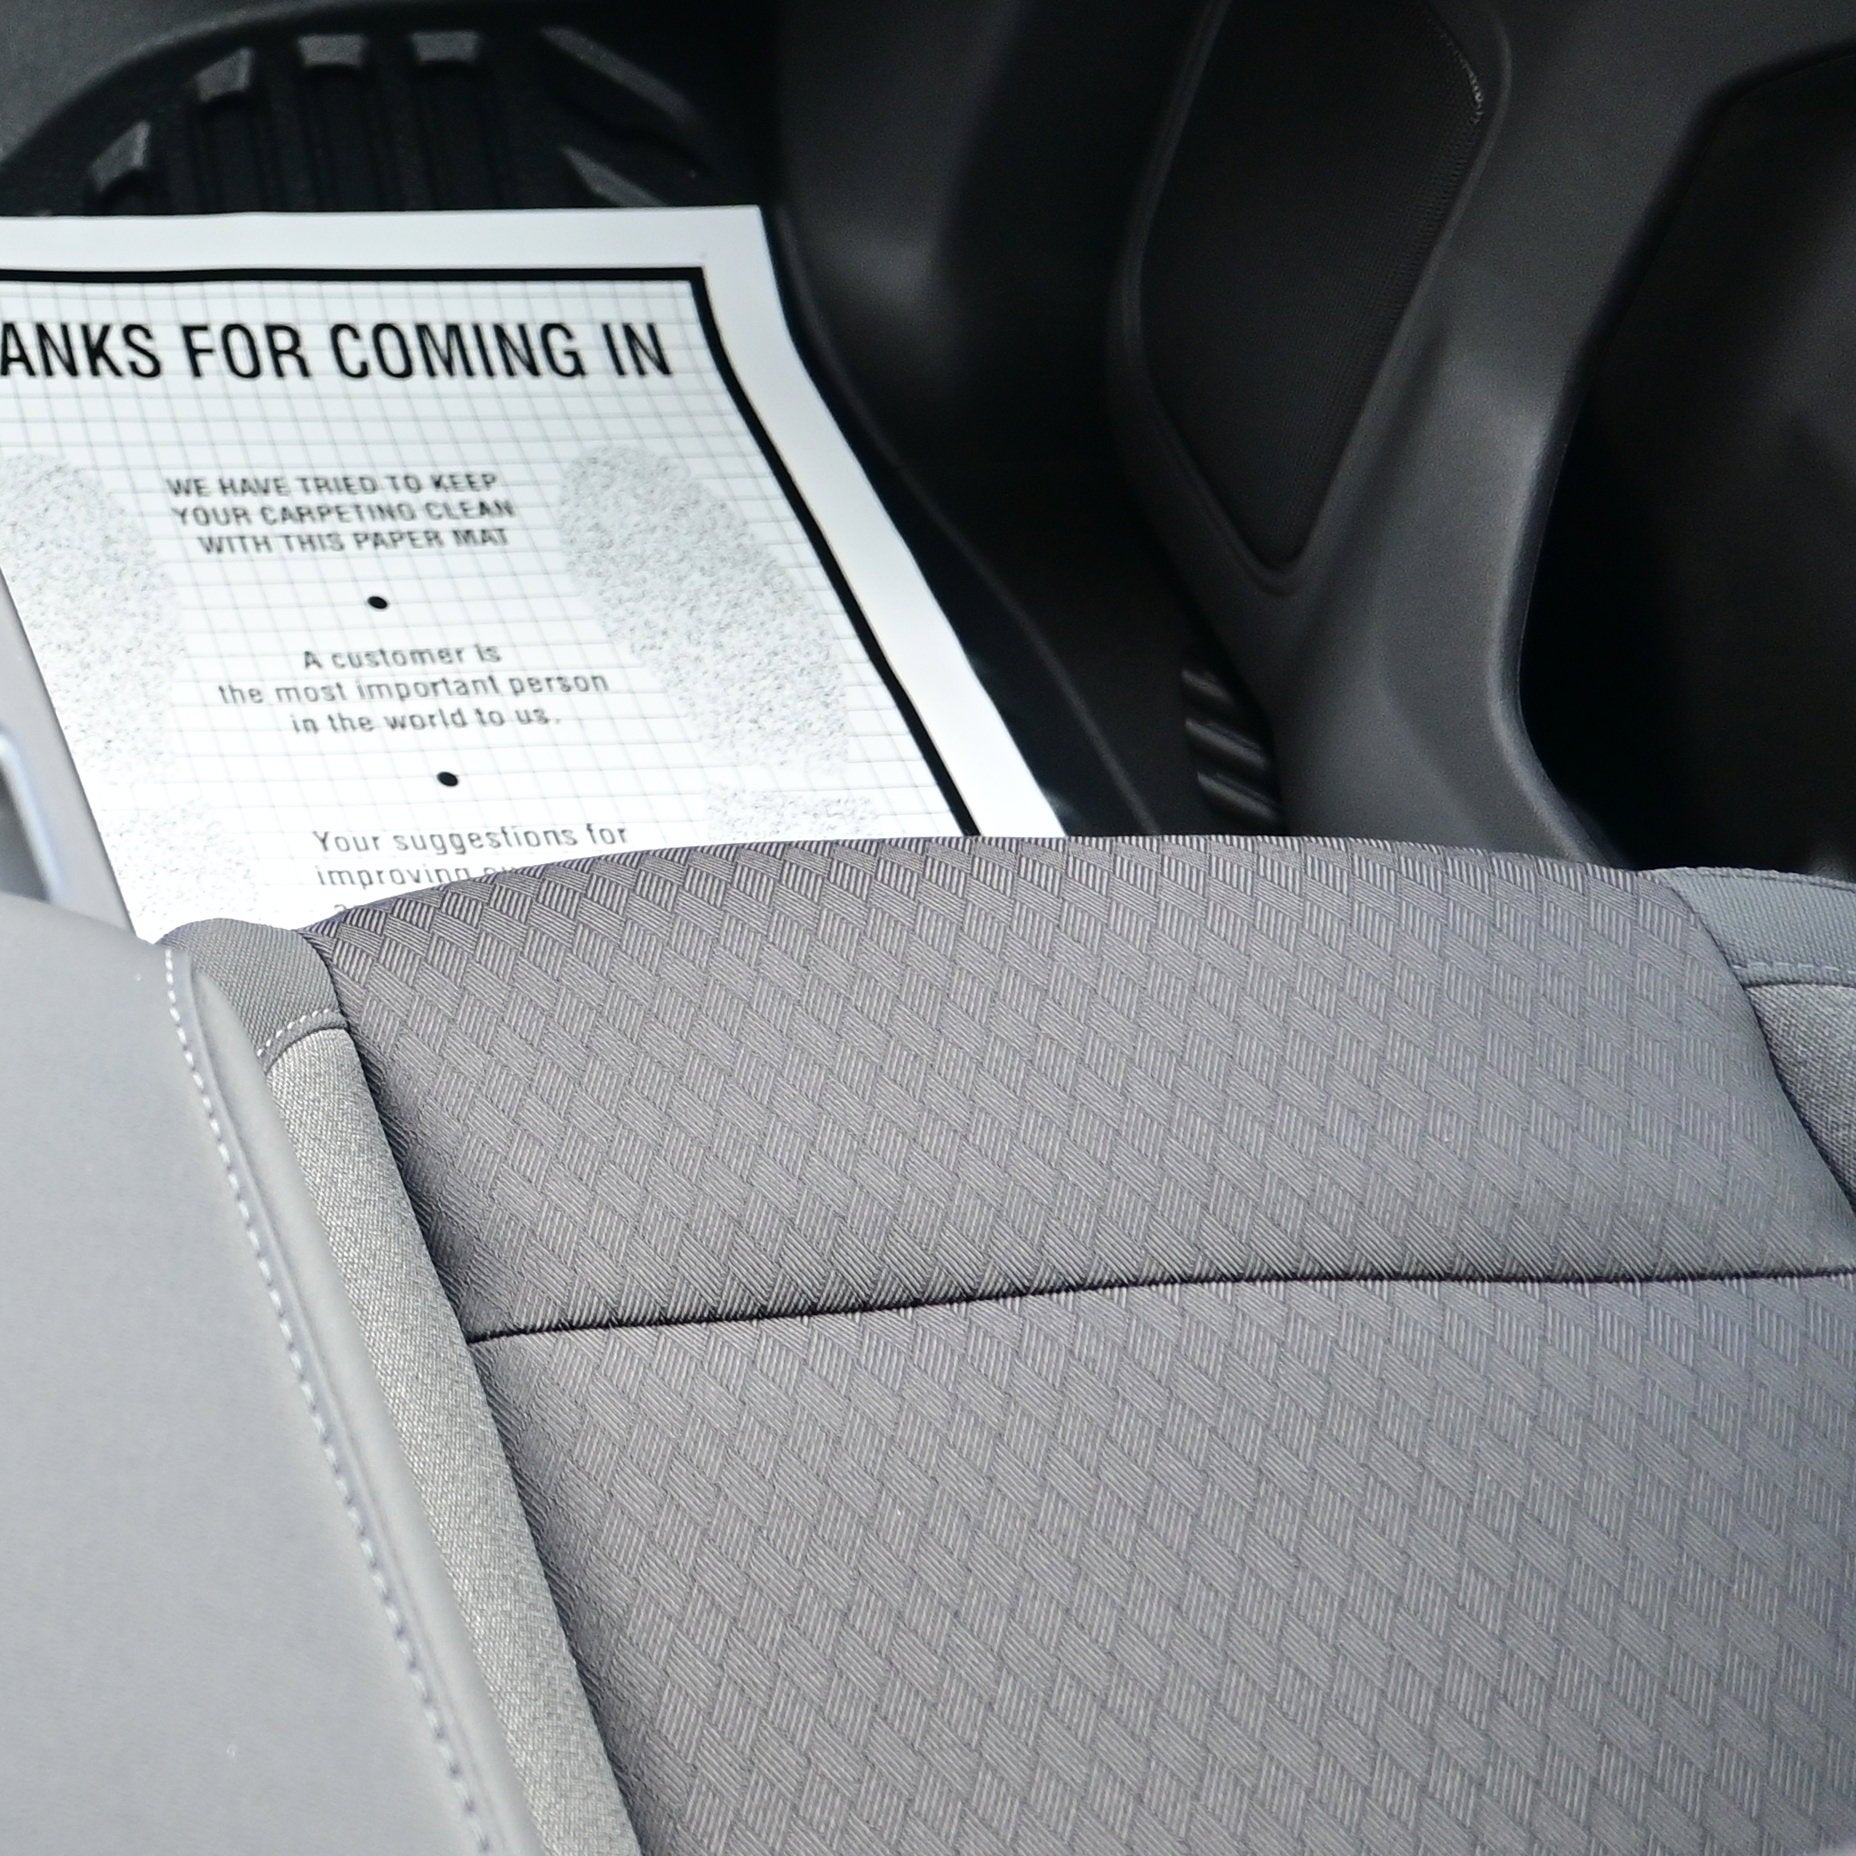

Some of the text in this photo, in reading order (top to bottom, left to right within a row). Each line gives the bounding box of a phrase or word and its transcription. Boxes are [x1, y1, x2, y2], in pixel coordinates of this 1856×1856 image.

[181, 322, 312, 380] FOR
[330, 321, 587, 380] COMING
[600, 321, 673, 378] IN
[166, 471, 499, 498] WE HAVE TRIED TO KEEP
[171, 498, 517, 527] YOUR CARPETING CLEAN
[197, 527, 512, 556] WITH THIS PAPER MAT
[302, 643, 503, 671] A customer is
[218, 672, 611, 706] the most important person
[290, 704, 562, 736] in the world to us.
[312, 822, 630, 856] Your suggestions for
